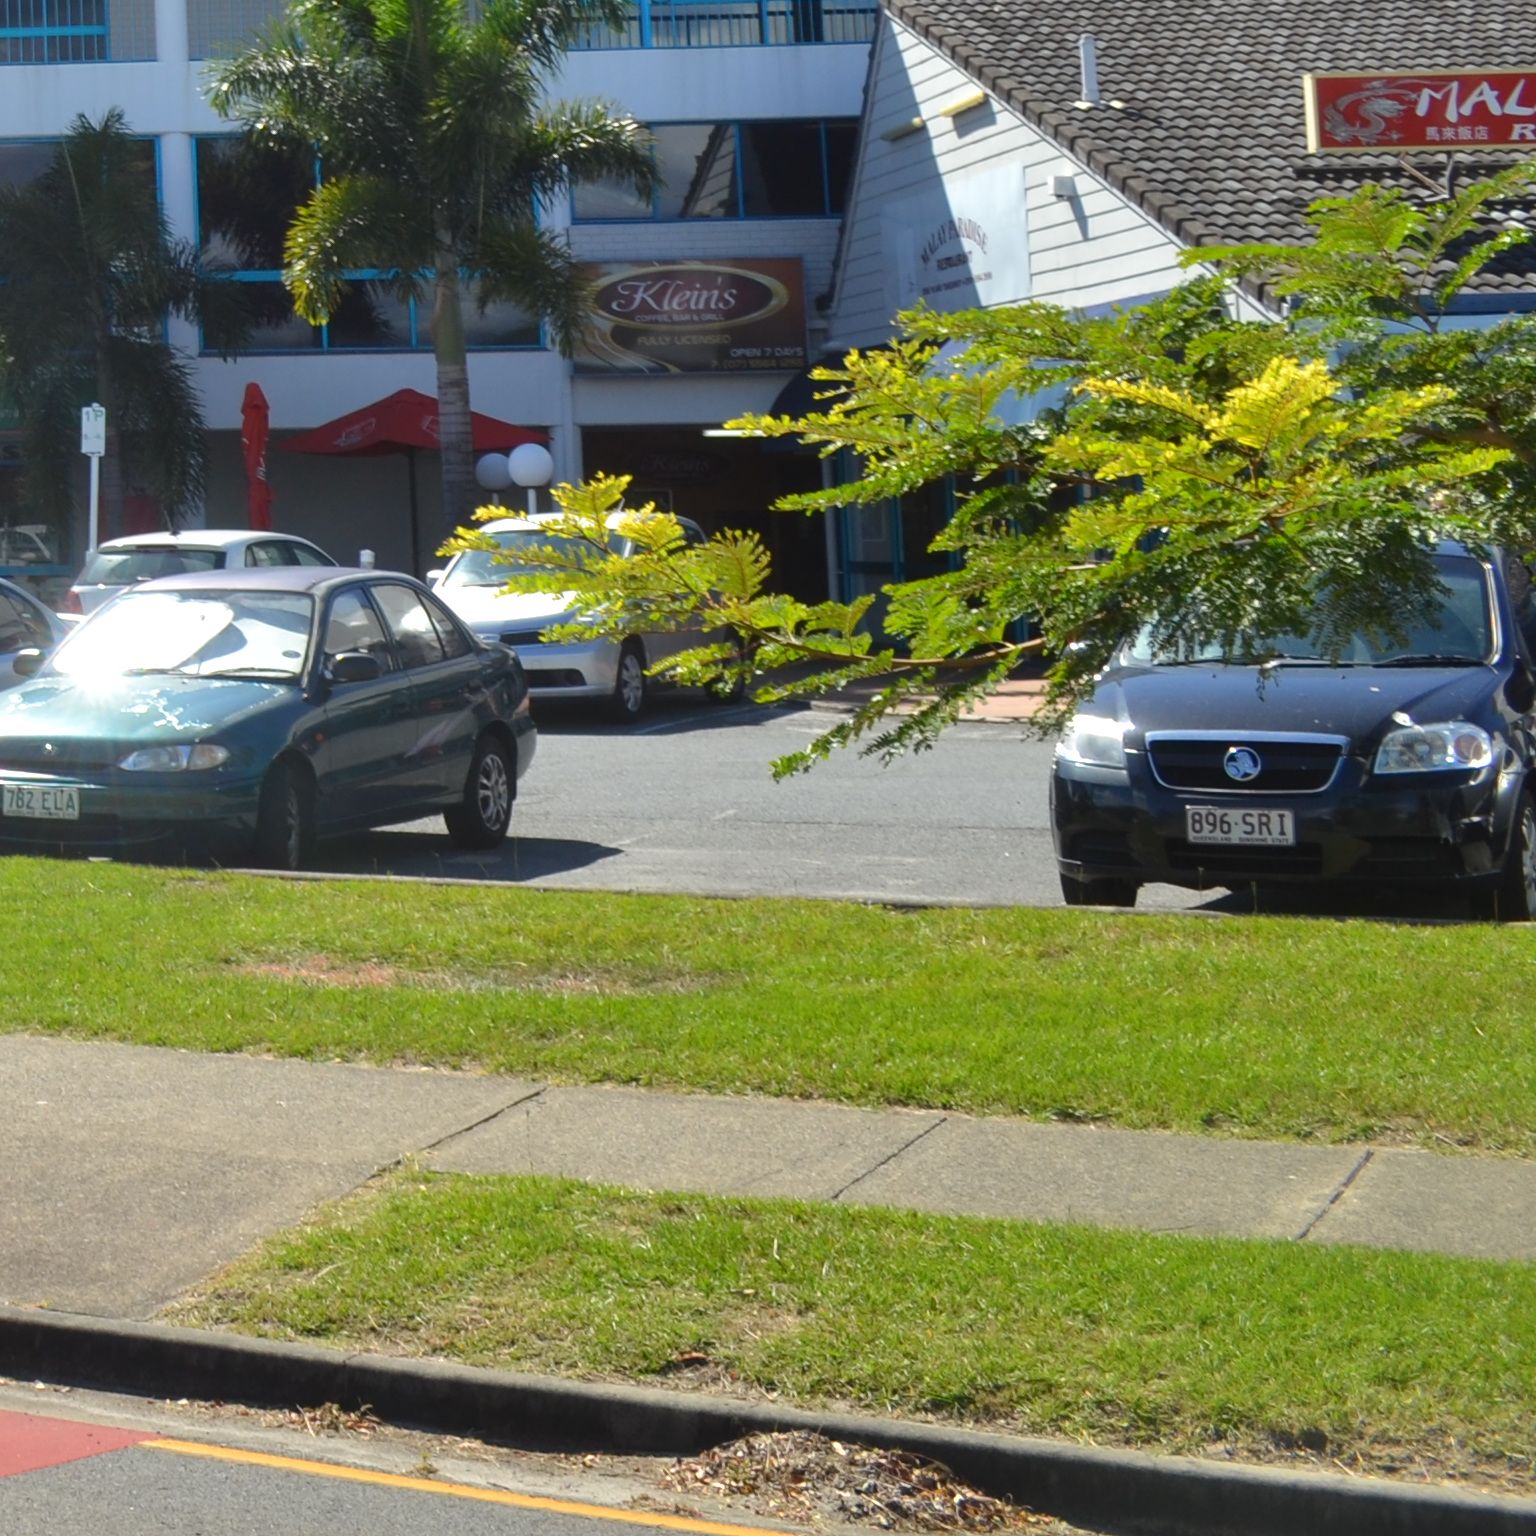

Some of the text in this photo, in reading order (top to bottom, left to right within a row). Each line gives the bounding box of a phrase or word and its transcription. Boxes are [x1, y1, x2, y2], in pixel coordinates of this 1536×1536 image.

[1415, 78, 1536, 124] MAL
[611, 276, 738, 313] Klein's
[637, 335, 673, 347] FULLY
[730, 348, 763, 359] OPEN
[774, 347, 805, 357] DAYS
